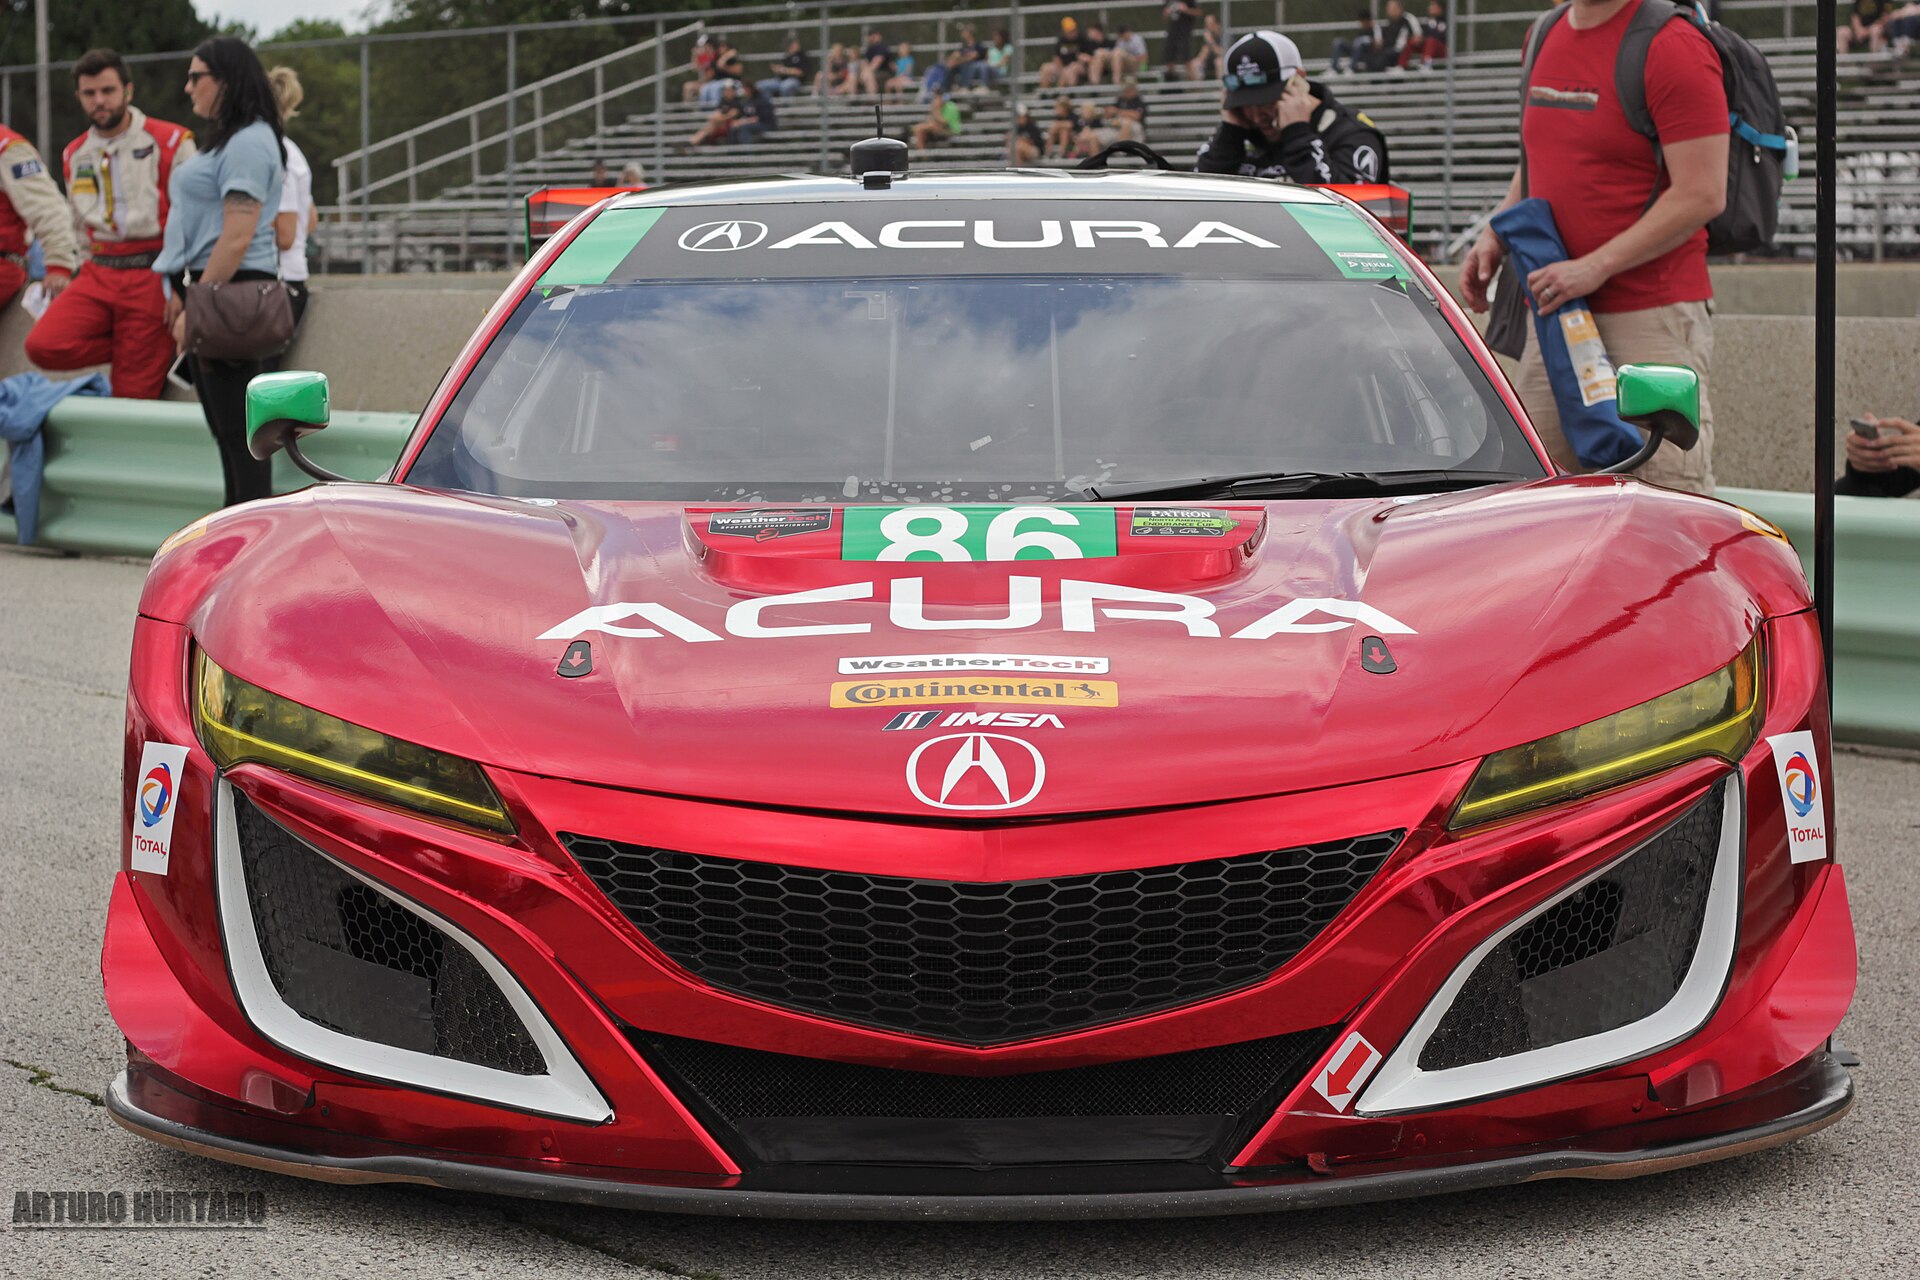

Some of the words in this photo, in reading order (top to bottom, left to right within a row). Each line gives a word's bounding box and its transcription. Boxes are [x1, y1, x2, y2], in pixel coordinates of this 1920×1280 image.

[768, 220, 1281, 249] ACURA
[716, 515, 826, 525] WeatherTech
[875, 506, 1084, 562] 86
[536, 576, 1418, 642] ACURA
[845, 681, 1066, 704] Continental
[939, 711, 1065, 729] IMSA
[134, 834, 167, 855] TOTAL
[1790, 827, 1823, 843] TOTAL
